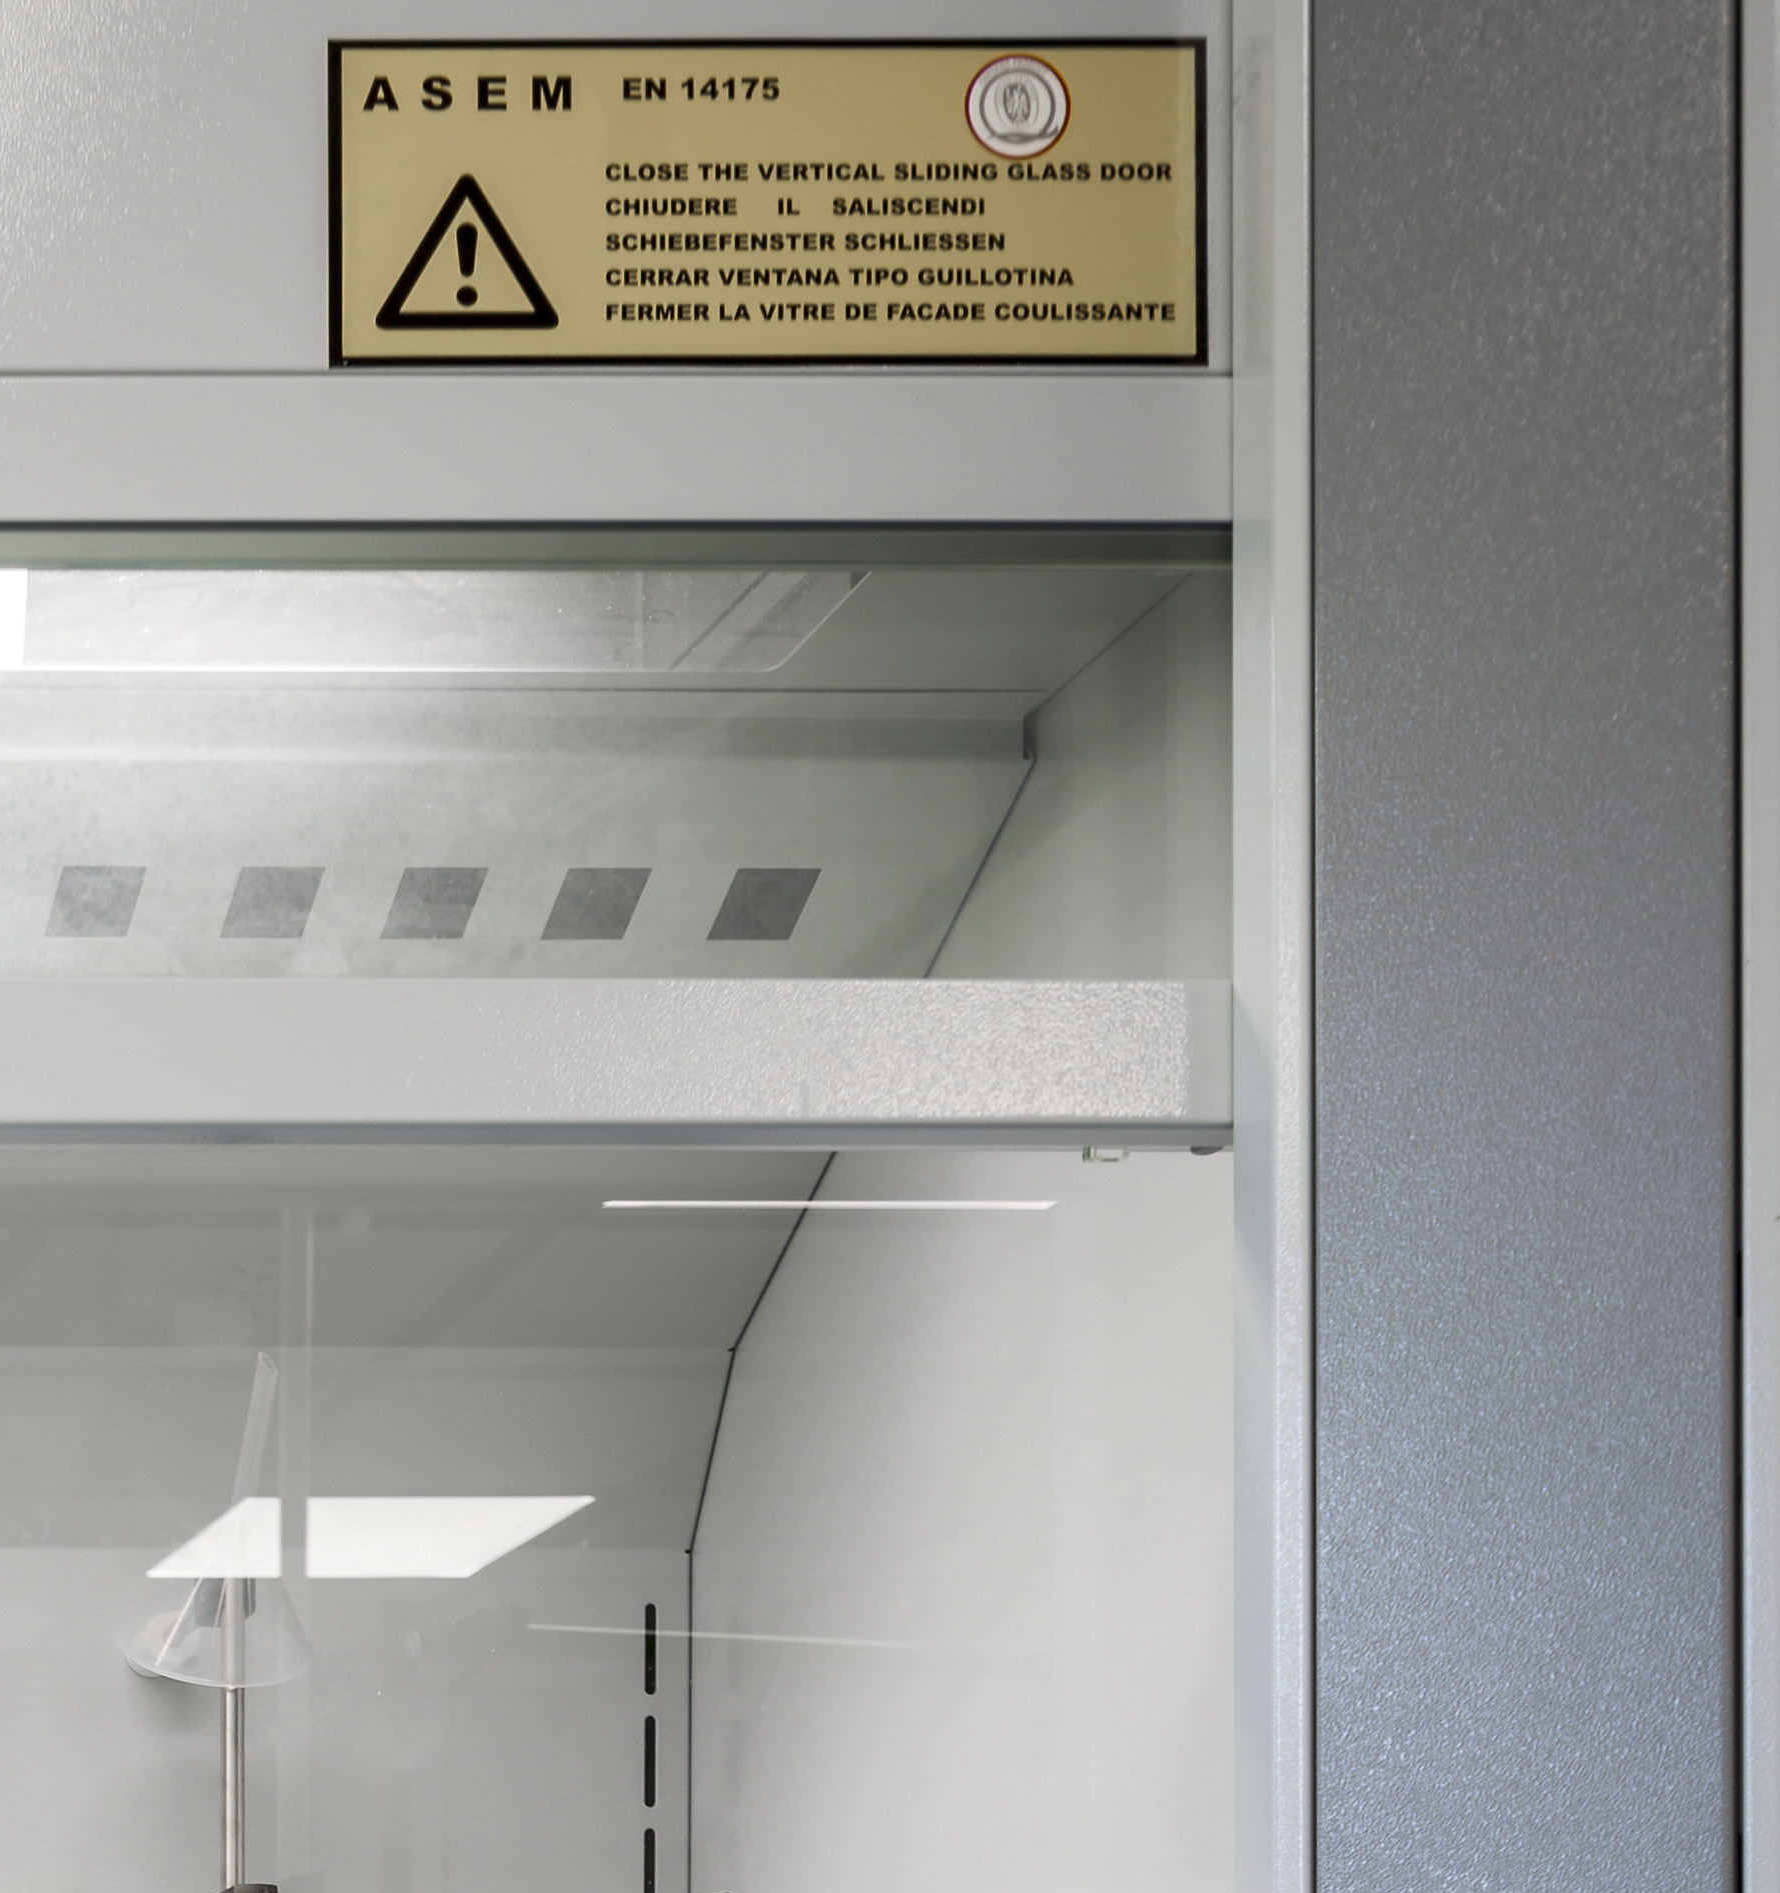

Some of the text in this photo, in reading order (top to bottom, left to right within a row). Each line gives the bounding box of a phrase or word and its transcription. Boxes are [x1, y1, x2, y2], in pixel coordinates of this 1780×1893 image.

[623, 78, 779, 100] EN 14175
[606, 164, 1171, 181] CLOSE THE VERTICAL SLIDING GLASS DOOR
[606, 198, 984, 215] CHIUDERE IL SALISCENDI
[607, 234, 1004, 250] SCHIEBEFENSTER SCHLIESSEN
[606, 269, 1073, 286] CERRAR VENTANA TIPO GUILLOTINA
[607, 304, 1175, 320] FERMER LA VITRE DE FACADE COULISSANTE
